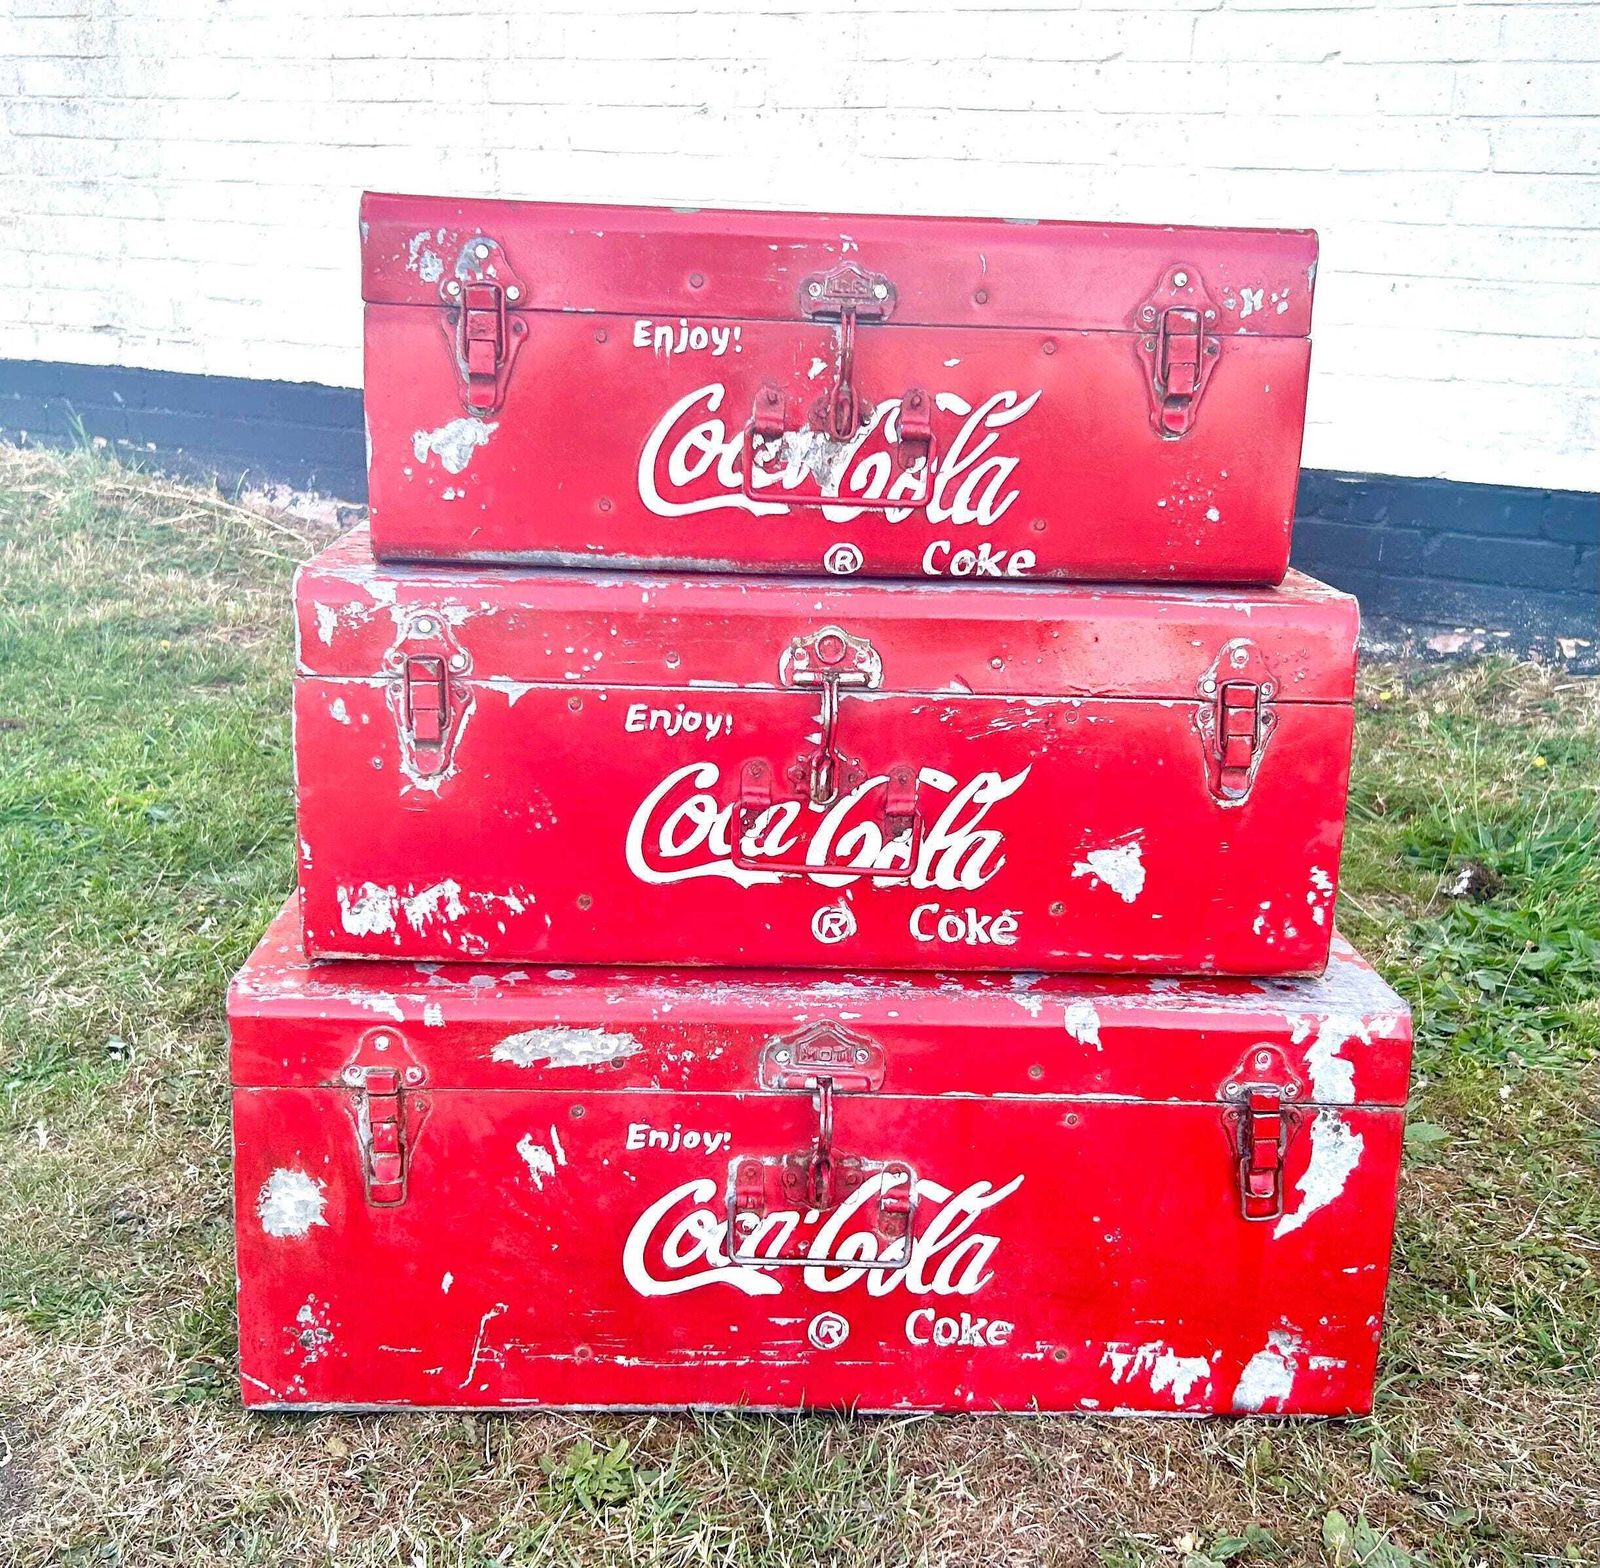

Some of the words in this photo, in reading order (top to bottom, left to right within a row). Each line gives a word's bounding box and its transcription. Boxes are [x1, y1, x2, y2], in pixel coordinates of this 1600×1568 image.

[634, 320, 742, 356] Enjoy!
[922, 541, 1036, 576] Coke
[624, 703, 734, 740] Enjoy!
[909, 903, 1021, 945] Coke
[905, 1307, 1014, 1347] Coke
